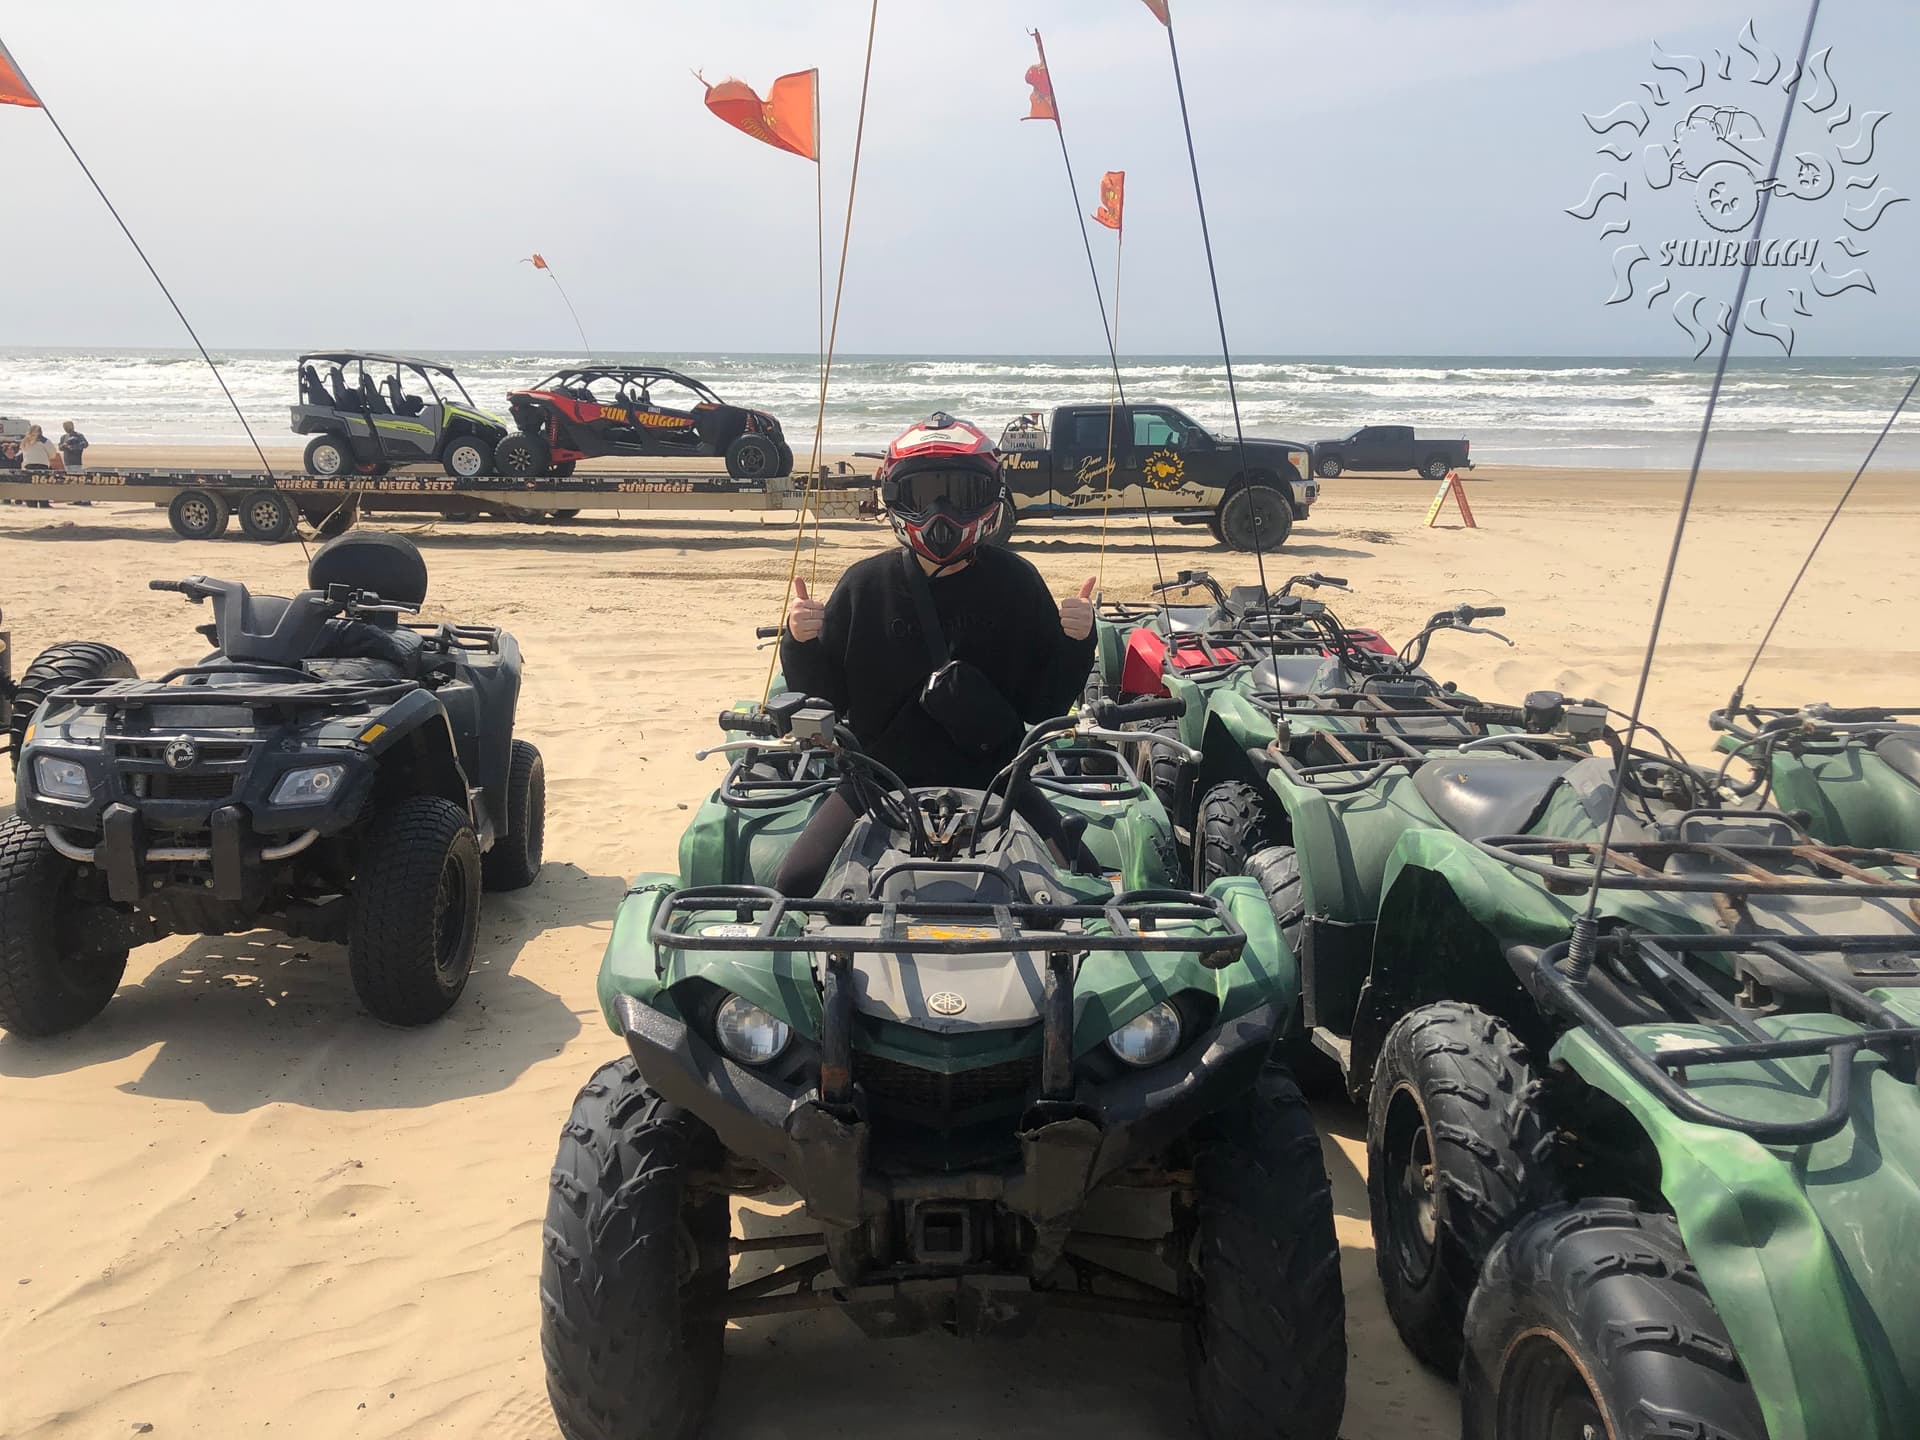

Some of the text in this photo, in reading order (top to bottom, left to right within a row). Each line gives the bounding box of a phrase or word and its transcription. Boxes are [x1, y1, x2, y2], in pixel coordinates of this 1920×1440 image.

[600, 406, 627, 421] SUN
[274, 479, 318, 489] WHERE
[322, 480, 346, 489] THE
[379, 480, 421, 490] NEVER
[424, 480, 454, 490] SETS
[617, 483, 694, 493] SUNBUGGIE
